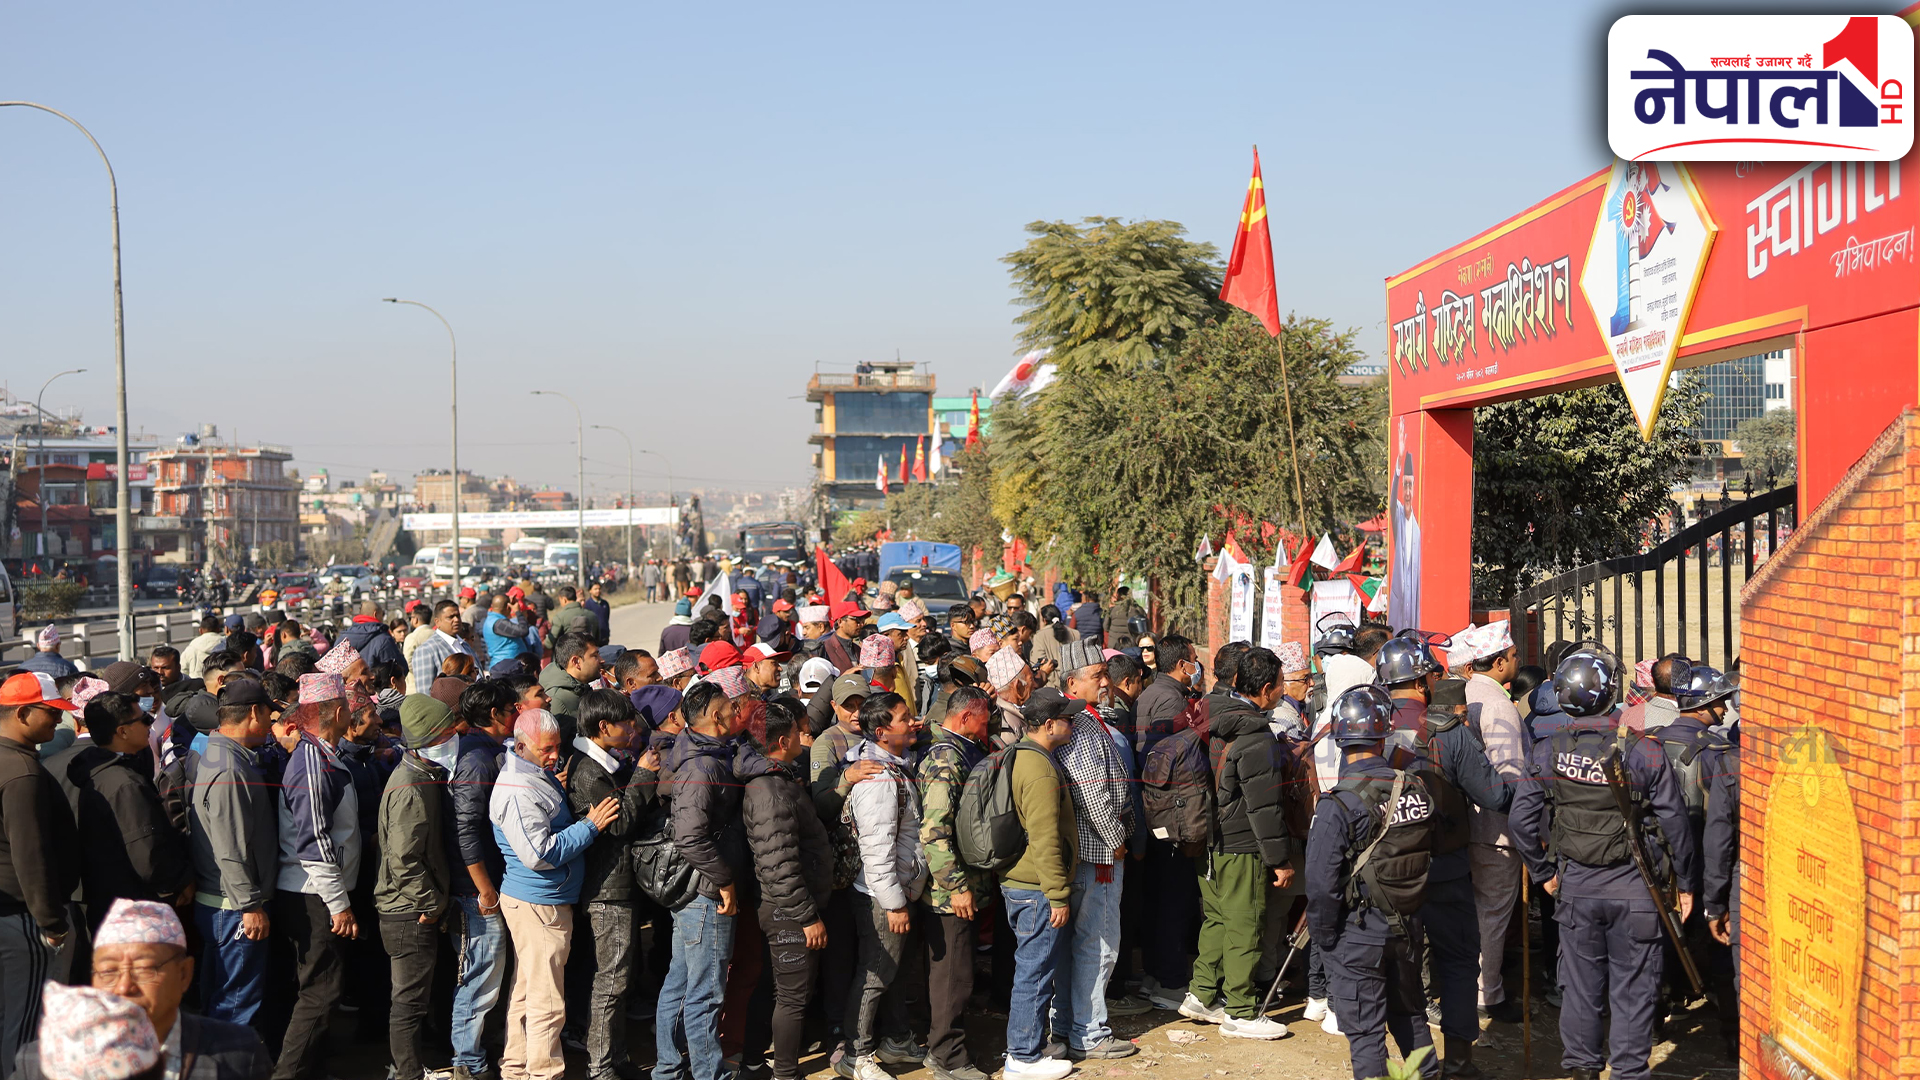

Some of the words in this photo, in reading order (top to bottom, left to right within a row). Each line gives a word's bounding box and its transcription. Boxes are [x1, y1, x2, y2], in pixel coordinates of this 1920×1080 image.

[1829, 225, 1915, 278] अभिवादन!
[1479, 256, 1573, 350] महाधिवेशन
[1557, 752, 1604, 772] NEPA
[1379, 794, 1427, 815] NPAL
[1383, 806, 1429, 825] OLICE
[1797, 841, 1827, 889] नेपाल
[1804, 945, 1844, 1009] (एमाले)
[1812, 1007, 1840, 1045] कमिटी
